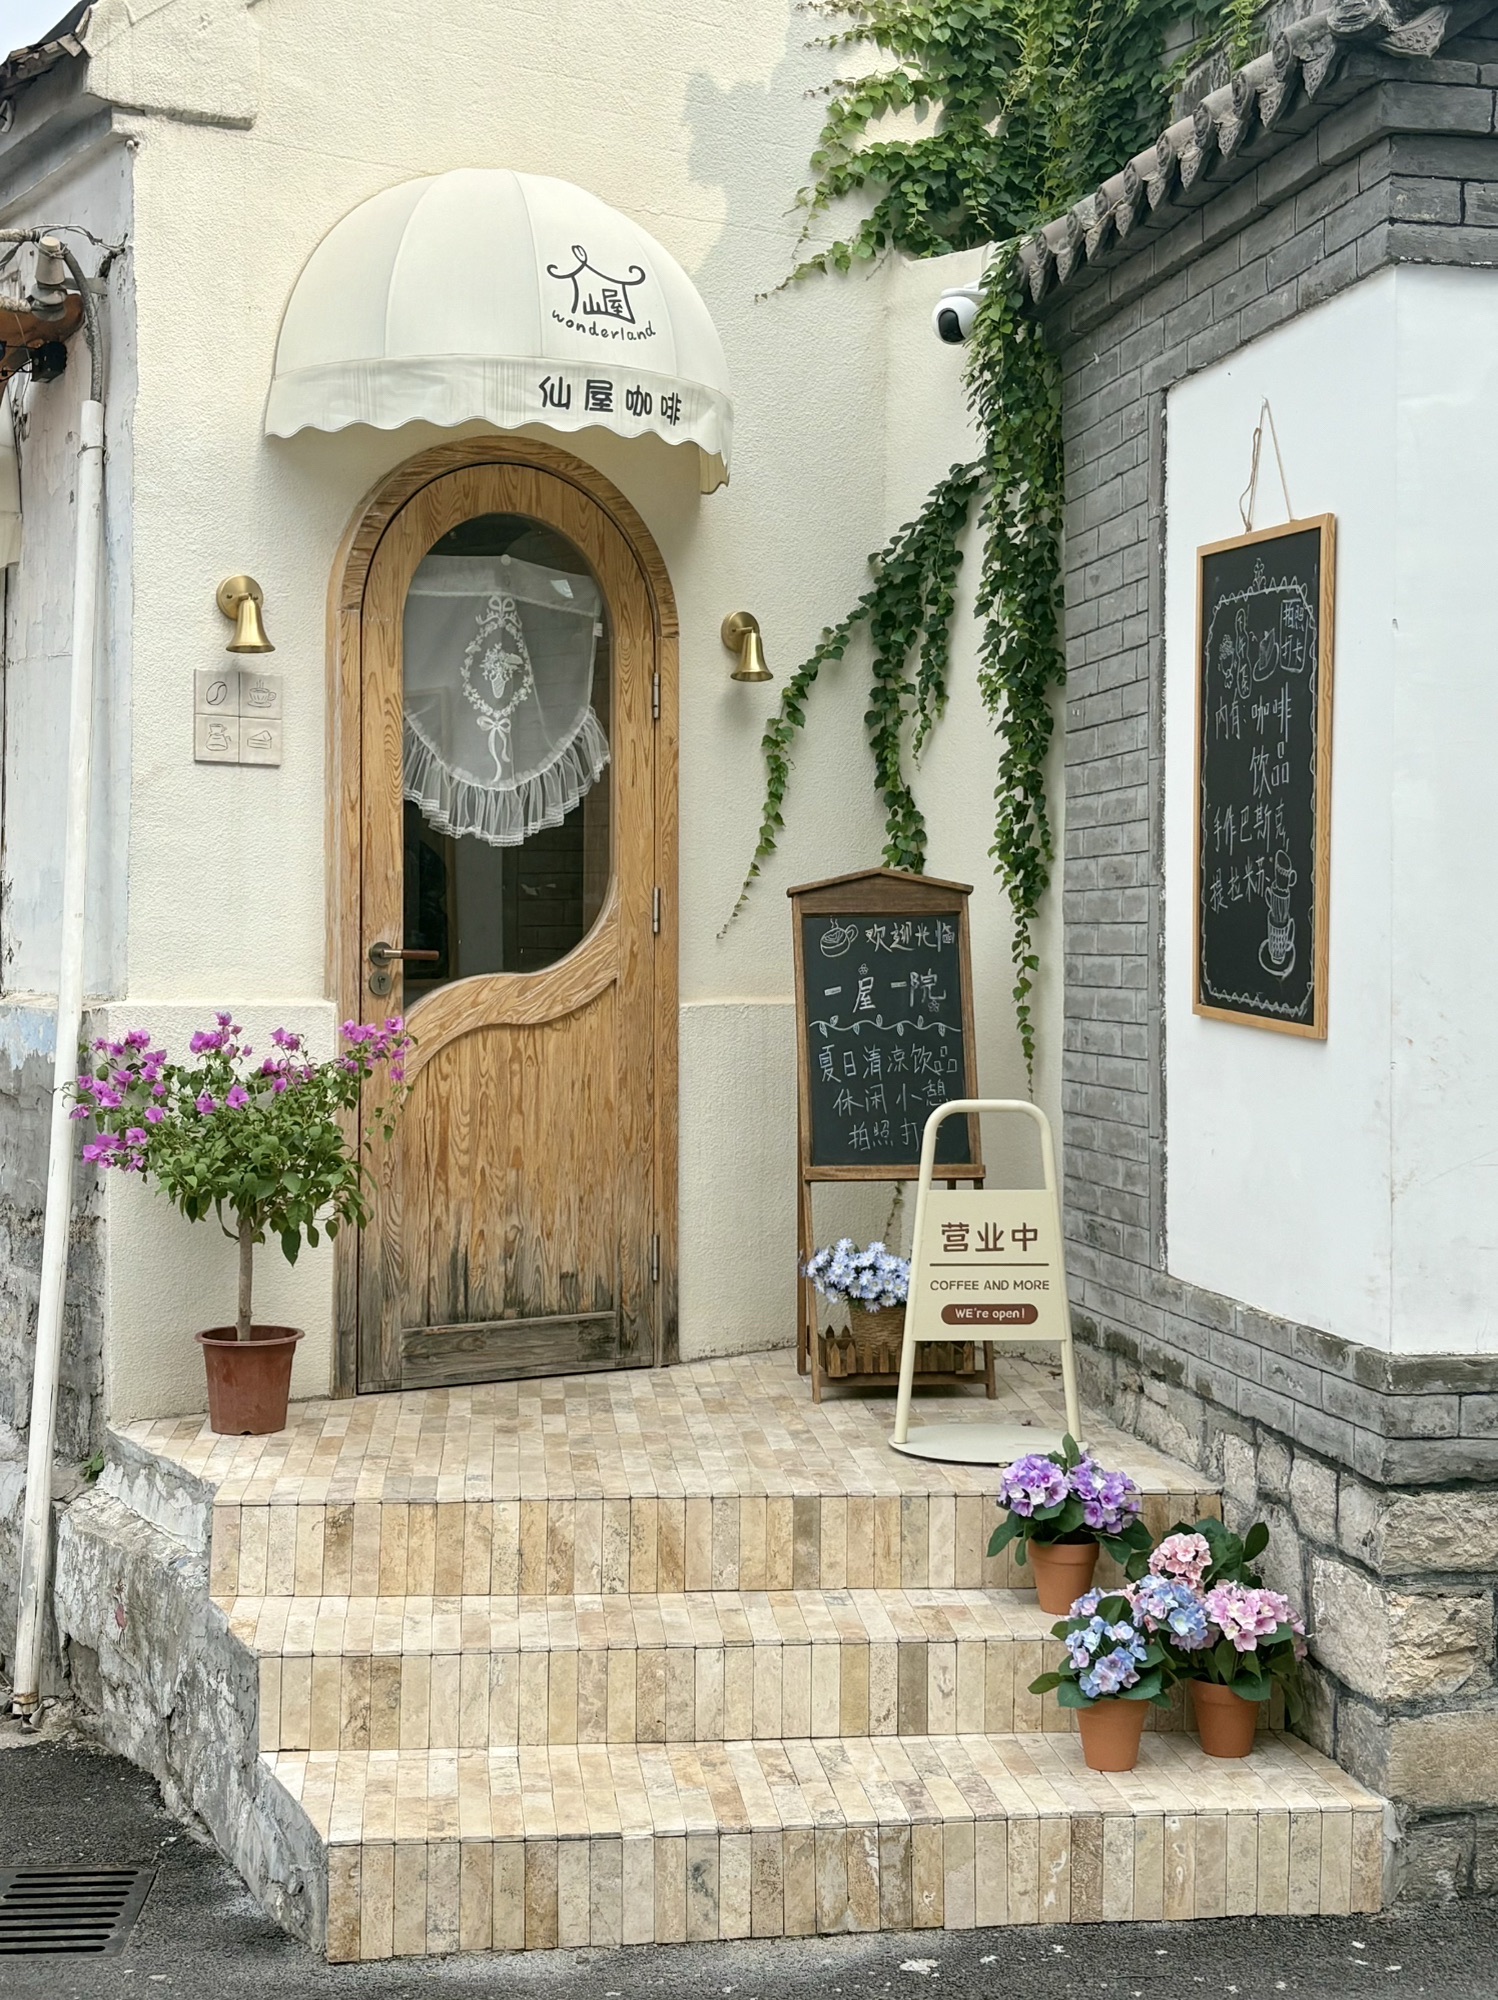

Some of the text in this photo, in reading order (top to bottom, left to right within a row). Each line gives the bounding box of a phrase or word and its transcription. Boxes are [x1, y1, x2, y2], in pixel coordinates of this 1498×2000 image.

[551, 309, 657, 341] wonderland
[538, 375, 683, 426] 仙屋咖啡
[1249, 741, 1290, 799] 饮品
[1209, 855, 1271, 914] 提拉米苏
[864, 919, 956, 953] 欢迎光临
[818, 1043, 958, 1083] 夏日清凉饮品
[832, 1078, 953, 1117] 休闲小憩
[848, 1117, 944, 1152] 拍照打
[940, 1221, 1038, 1253] 营业中
[929, 1279, 1050, 1291] COFFEE AND MORE
[954, 1307, 1025, 1321] WE're open!
